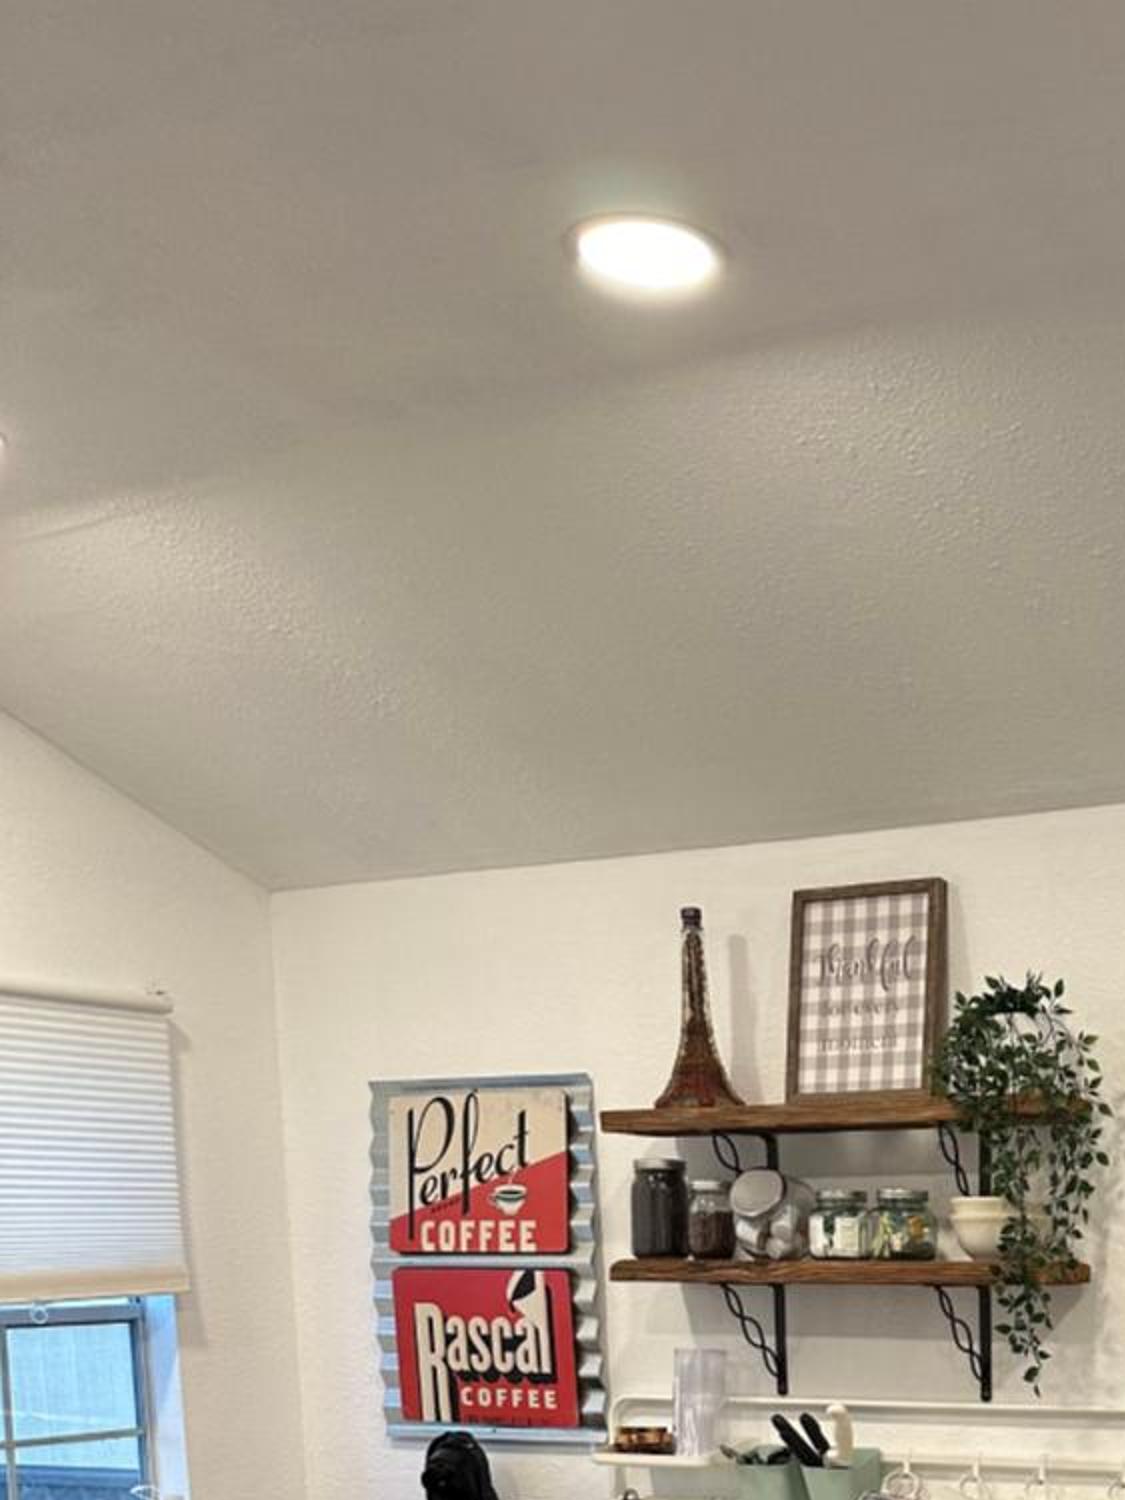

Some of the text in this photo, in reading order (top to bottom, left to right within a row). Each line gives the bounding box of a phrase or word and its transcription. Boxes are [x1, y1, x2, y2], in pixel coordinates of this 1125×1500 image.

[407, 1089, 529, 1241] Perfect
[420, 1219, 537, 1252] COFFEE
[414, 1272, 553, 1421] Rascal
[460, 1386, 558, 1409] COFFEE
